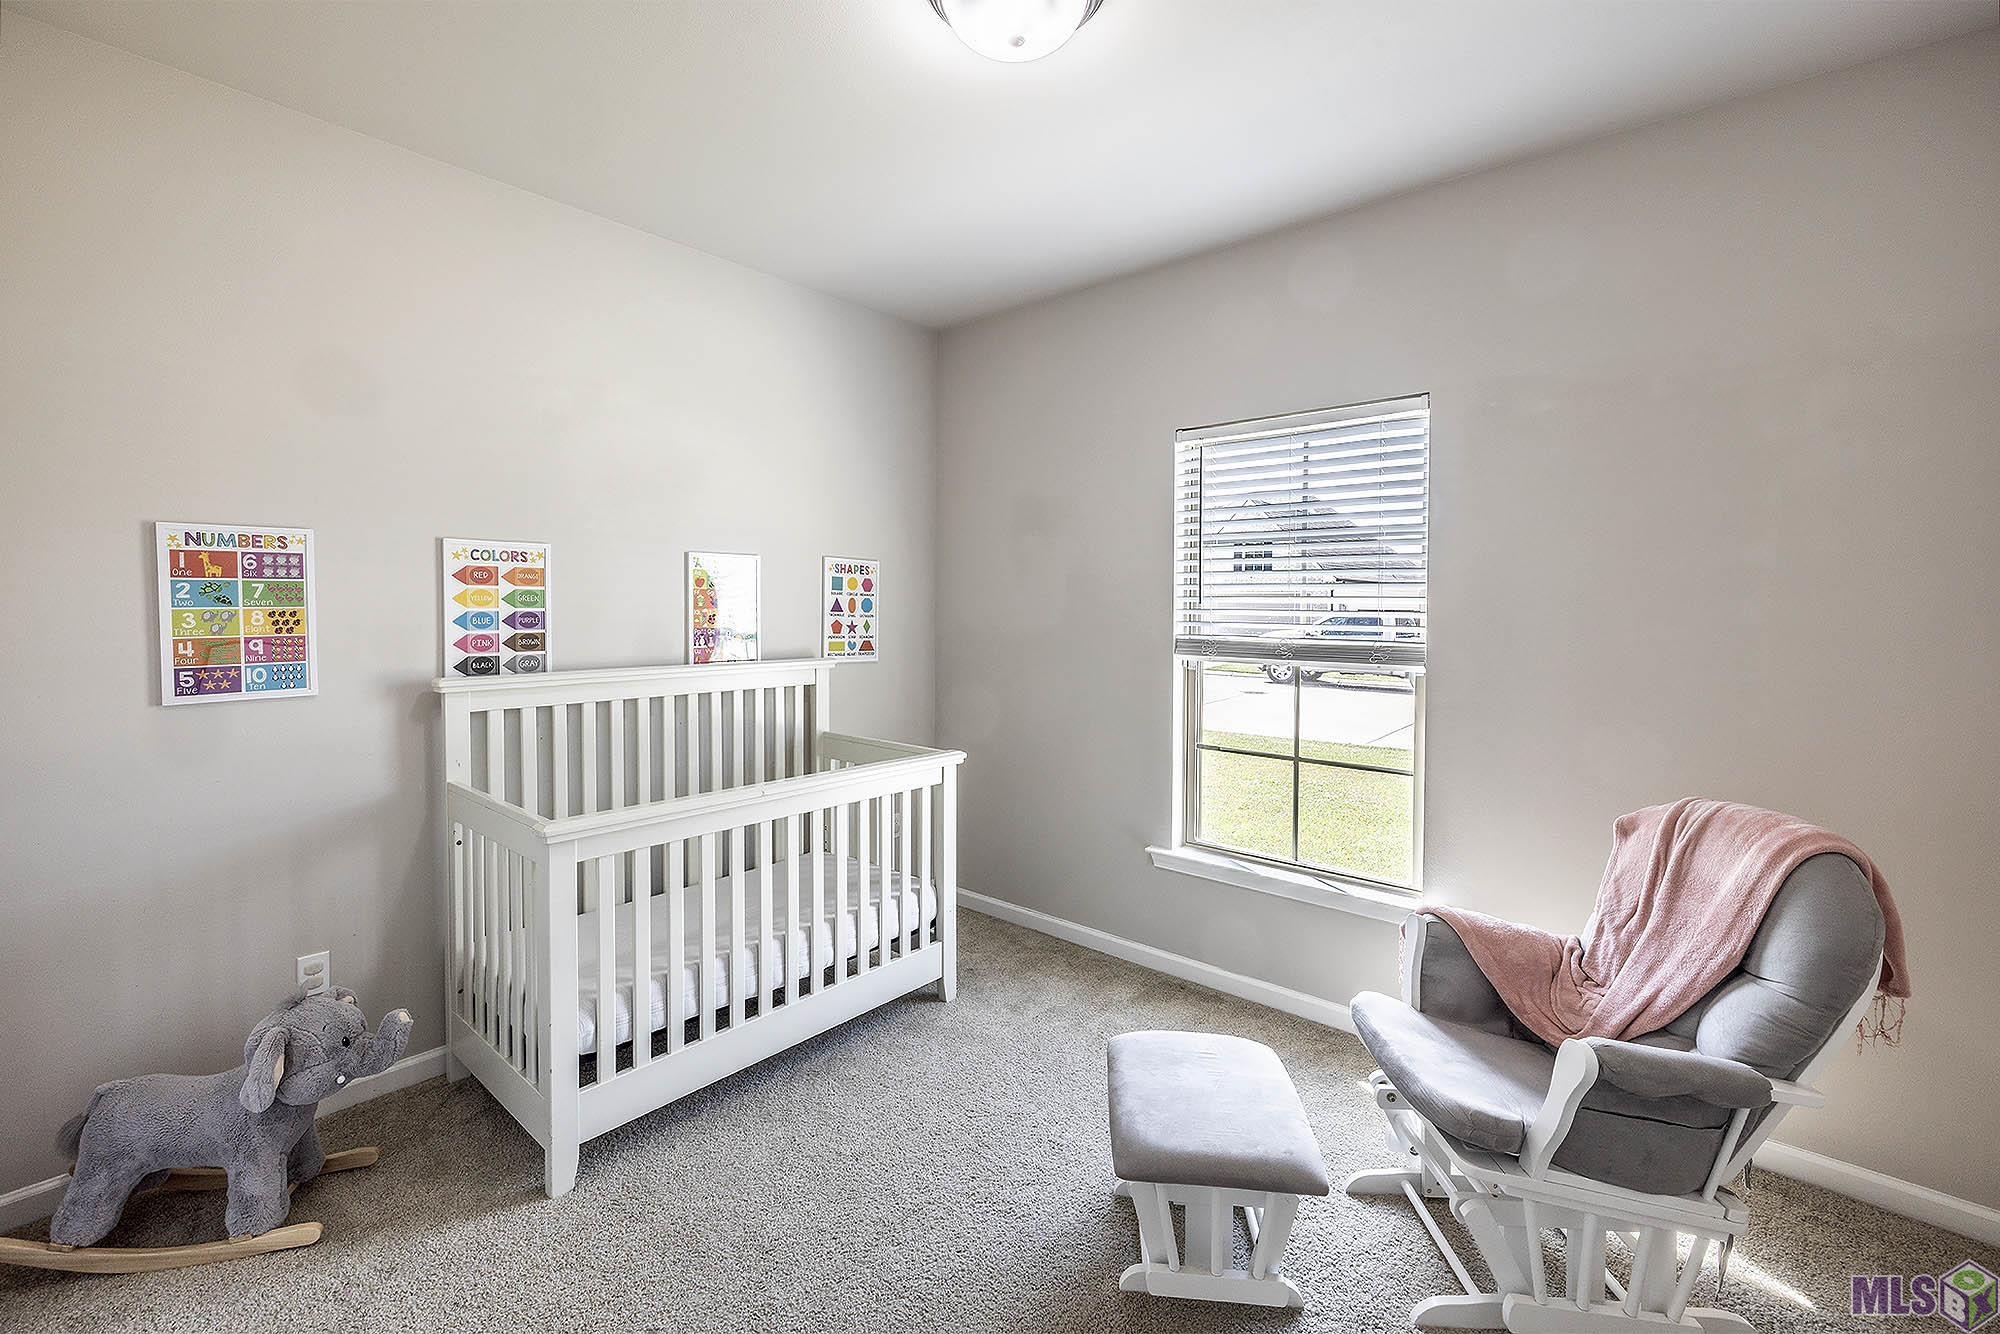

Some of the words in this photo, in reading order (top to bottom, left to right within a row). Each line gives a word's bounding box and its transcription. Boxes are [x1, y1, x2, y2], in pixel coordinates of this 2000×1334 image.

[184, 531, 289, 550] NUMBERS
[179, 552, 185, 568] 1
[242, 553, 257, 570] 6
[470, 548, 528, 563] COLORS
[172, 568, 193, 577] One
[243, 569, 258, 577] Six
[473, 571, 489, 579] RED
[834, 563, 870, 576] SHAPES
[175, 582, 191, 599] 2
[251, 583, 265, 599] 7
[517, 594, 540, 602] GREEN
[181, 612, 197, 629] 3
[251, 610, 265, 626] 8
[472, 616, 491, 625] BLUE
[174, 628, 205, 636] Three
[245, 625, 272, 634] Eight
[178, 641, 195, 657] 4
[248, 639, 264, 655] 9
[472, 639, 493, 647] PINK
[174, 657, 199, 665] Four
[245, 654, 267, 662] Nine
[179, 671, 195, 688] 5
[246, 667, 268, 684] 10
[176, 687, 198, 695] Five
